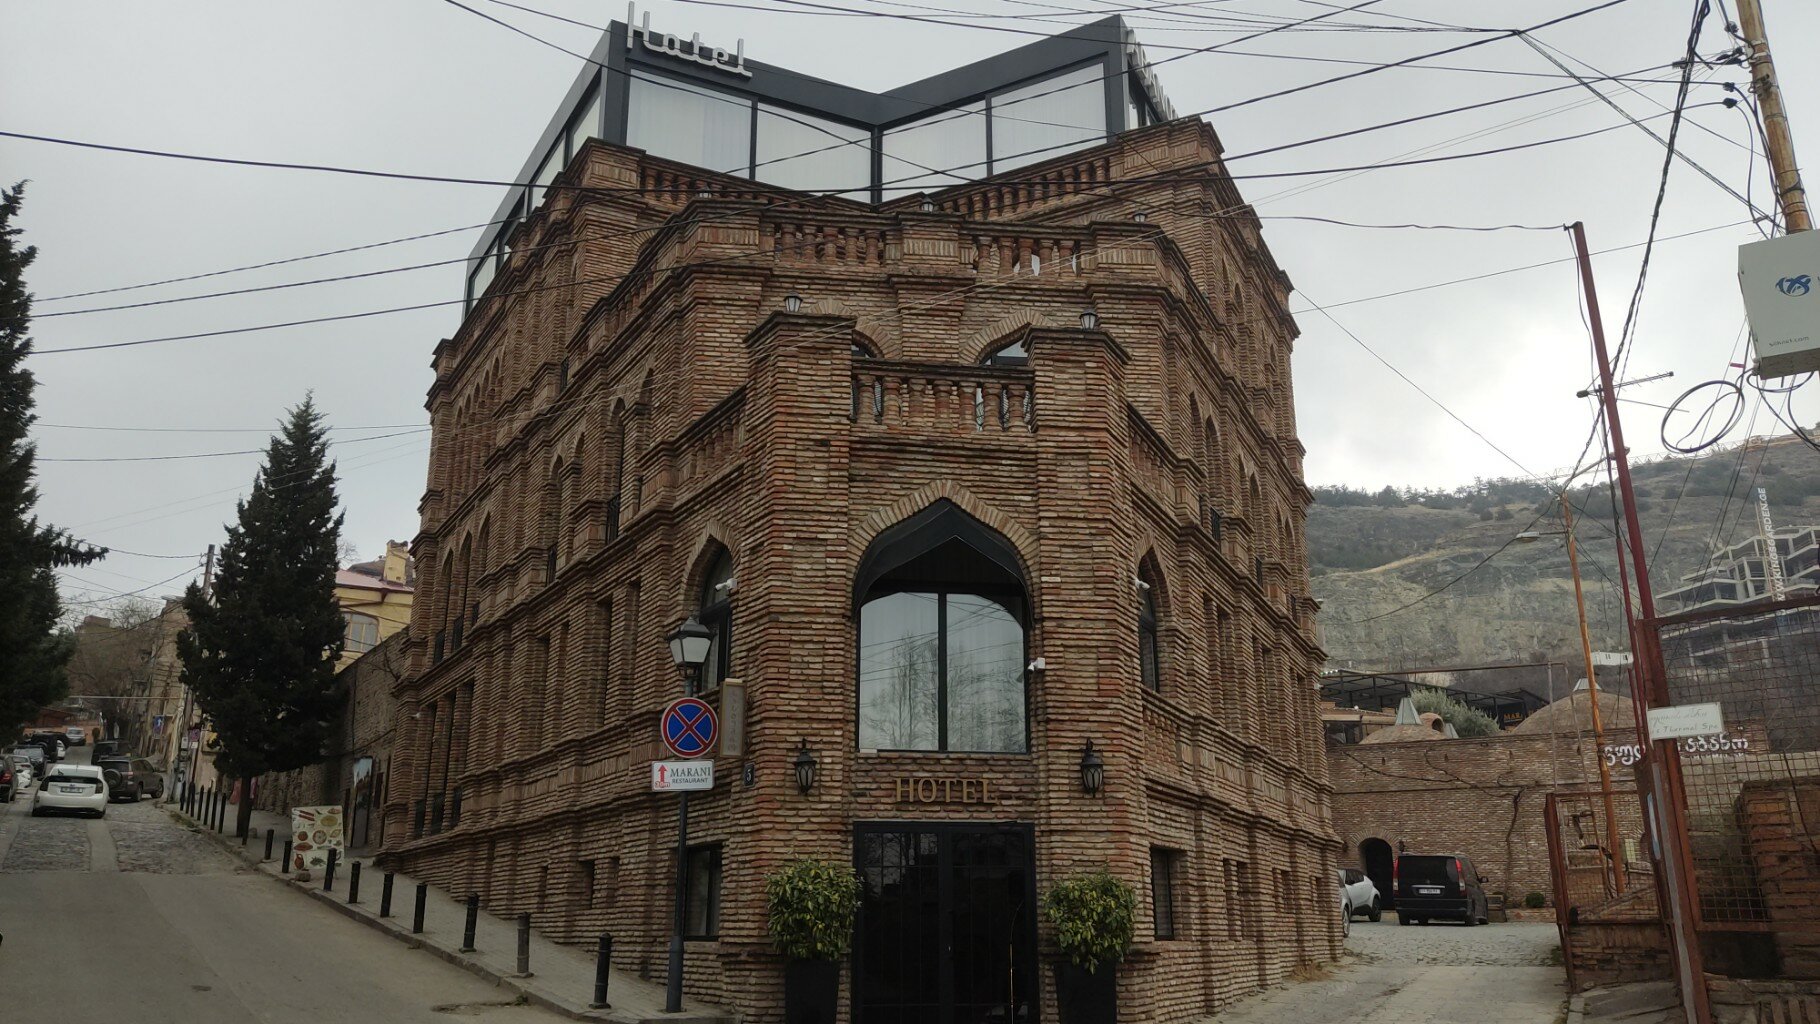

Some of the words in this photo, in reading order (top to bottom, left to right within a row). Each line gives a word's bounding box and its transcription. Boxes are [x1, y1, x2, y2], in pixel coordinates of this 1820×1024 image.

[627, 1, 752, 77] Hotel
[670, 767, 711, 778] MARANI
[896, 777, 998, 803] HOTEL
